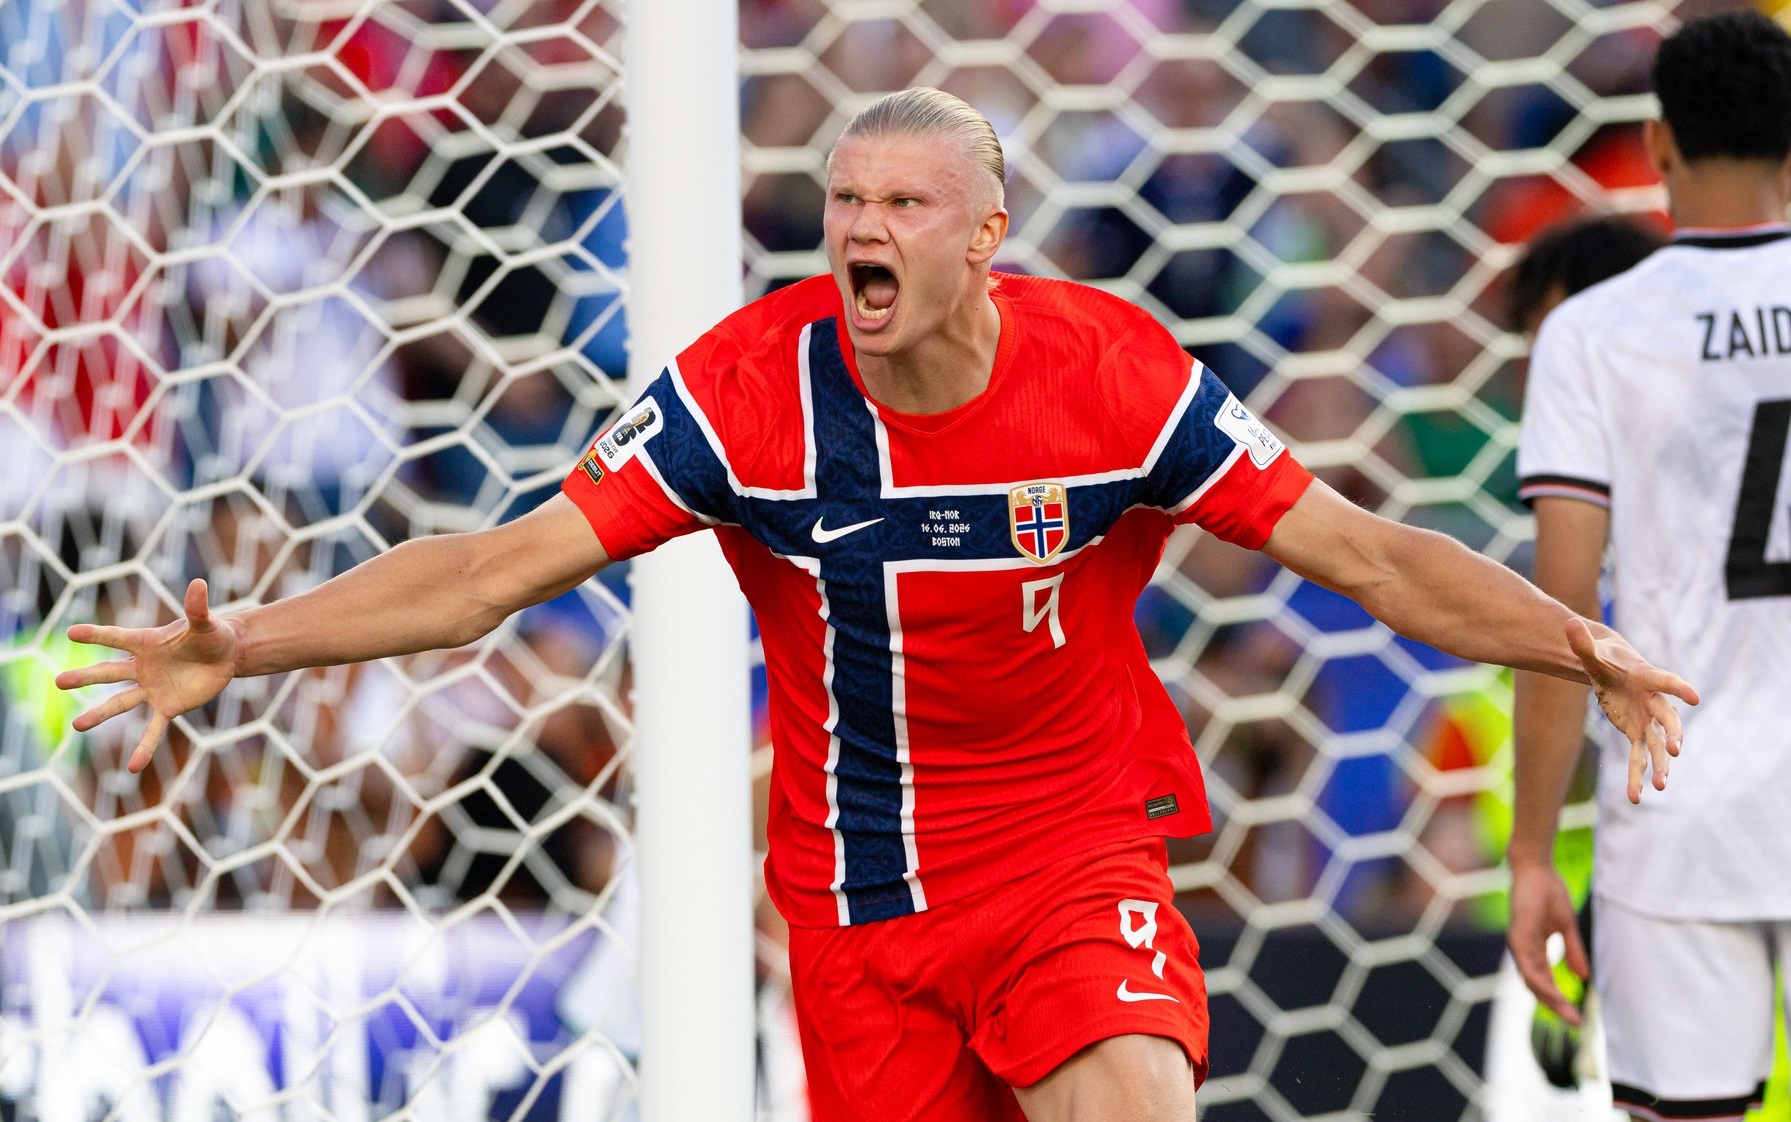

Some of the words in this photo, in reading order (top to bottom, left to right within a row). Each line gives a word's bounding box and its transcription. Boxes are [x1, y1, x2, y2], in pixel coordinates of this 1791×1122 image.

[1694, 306, 1791, 361] ZAID
[599, 440, 615, 459] 2026
[587, 459, 602, 477] DEBUT
[1027, 485, 1046, 495] NORGE
[929, 510, 960, 520] IRQ-NOR
[932, 537, 961, 547] BOSTON
[1021, 571, 1067, 650] 9
[1117, 898, 1167, 981] 9
